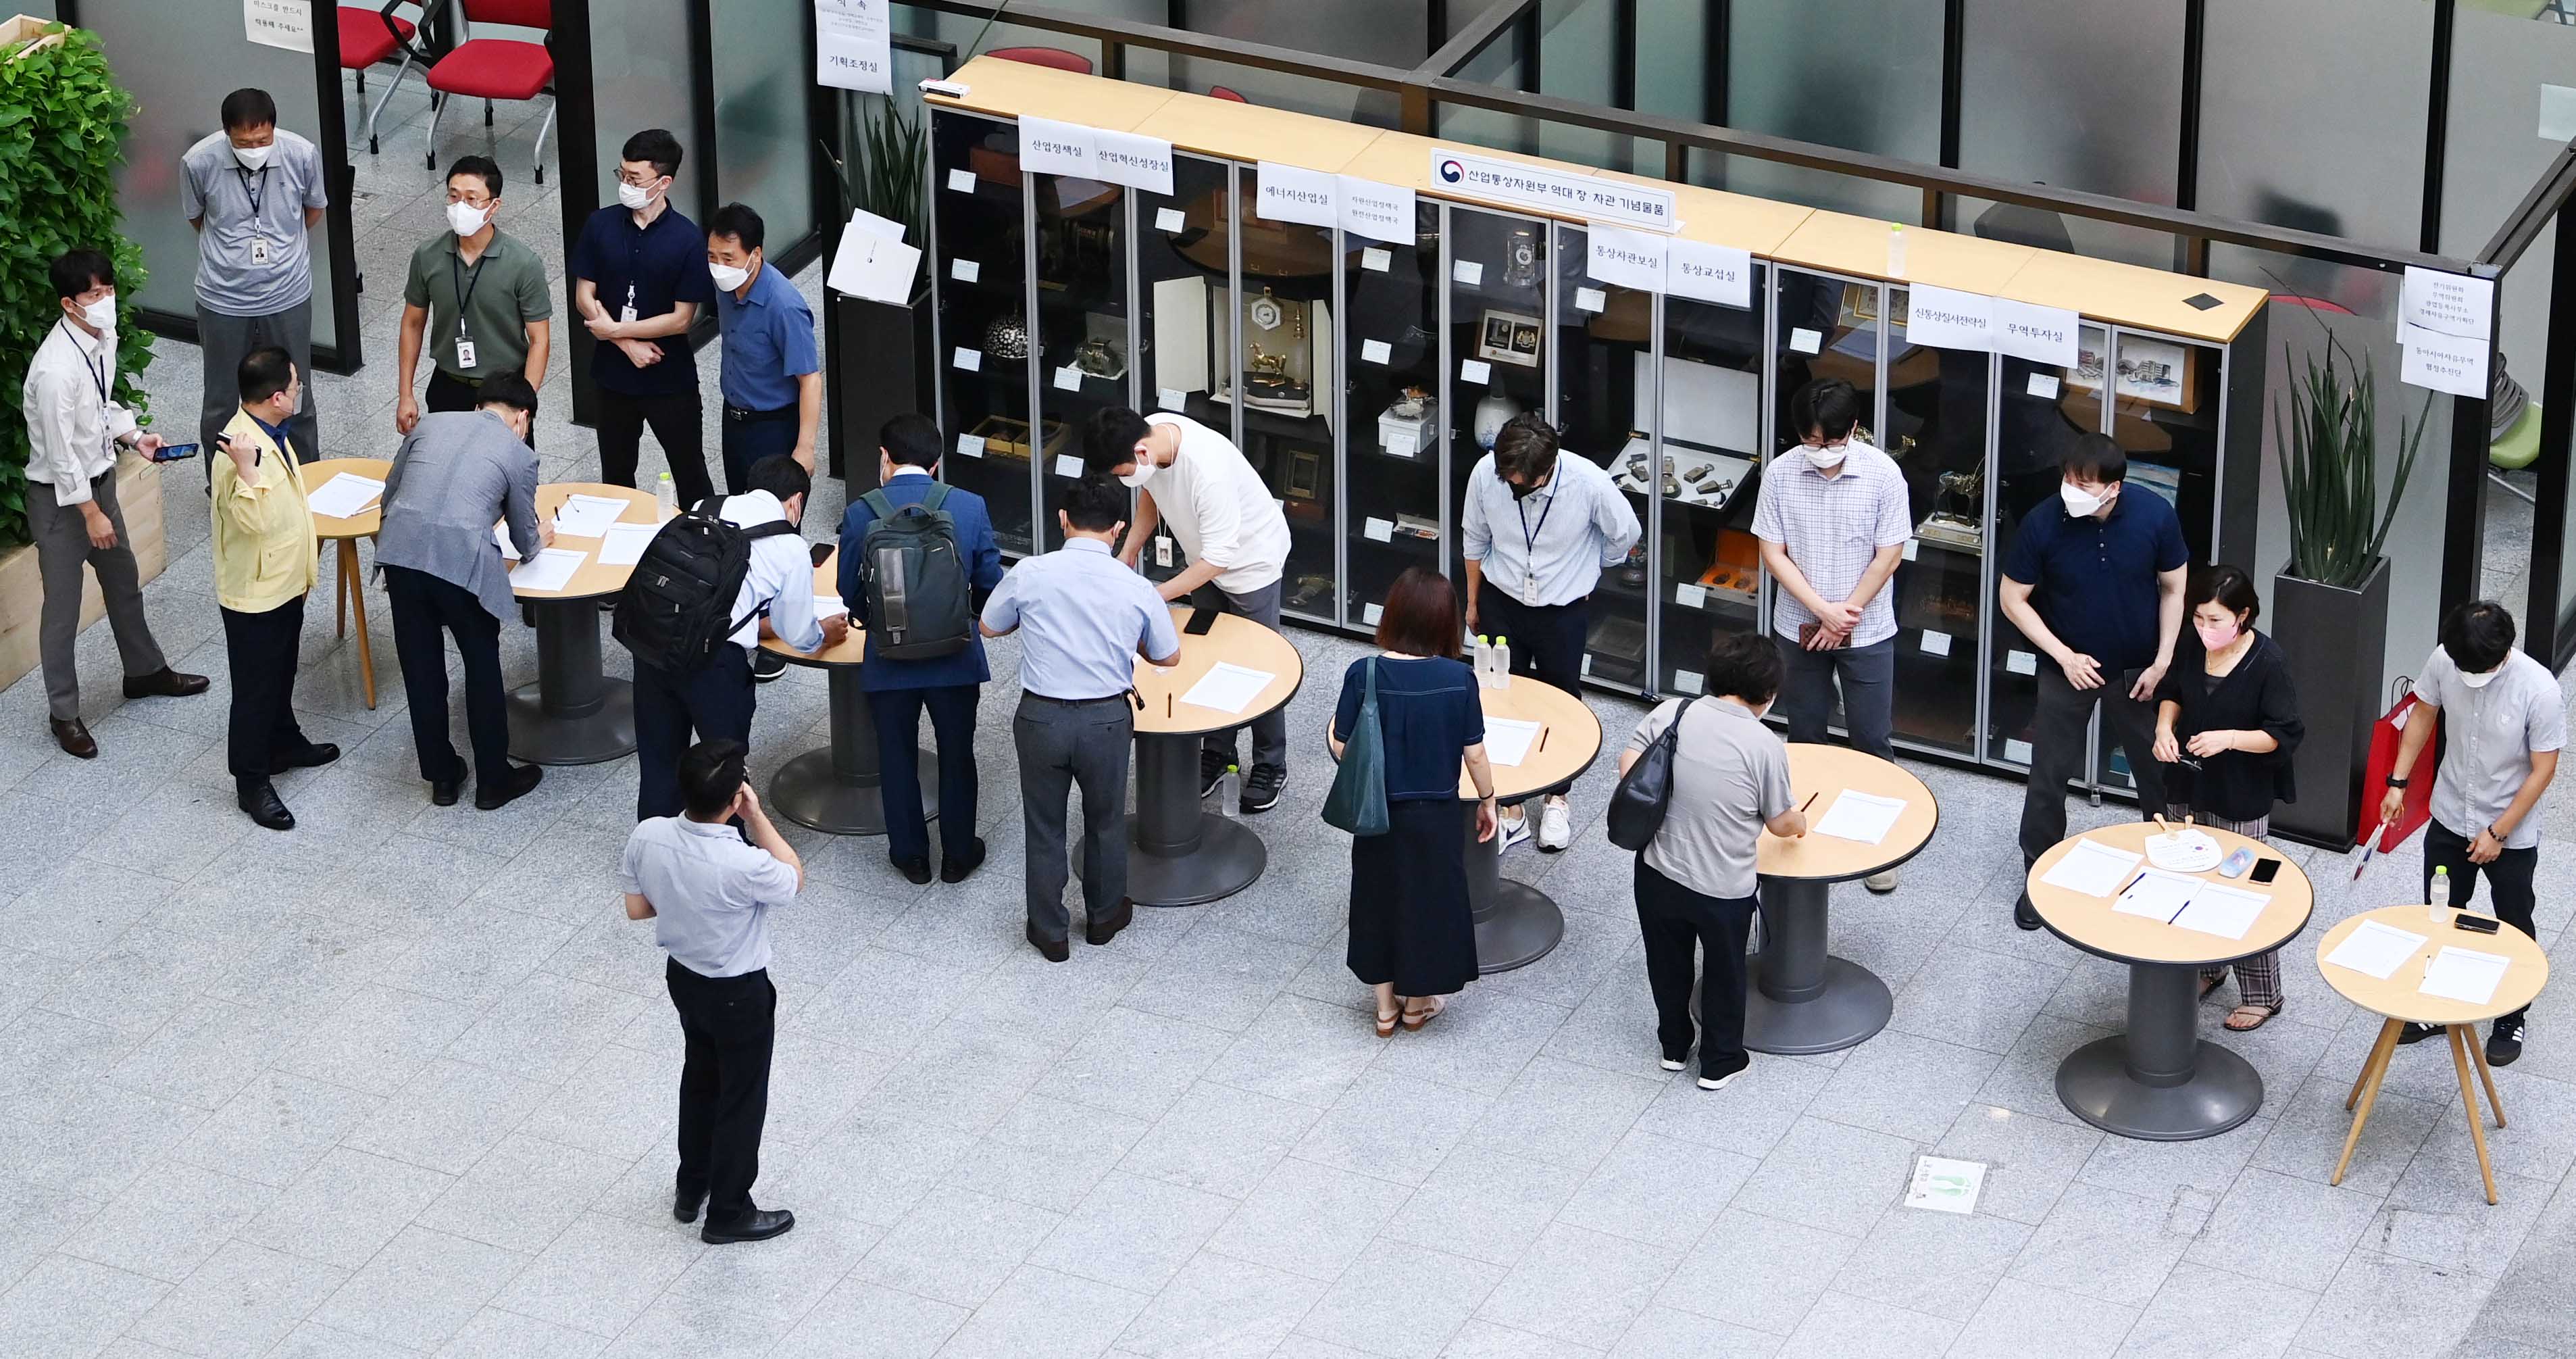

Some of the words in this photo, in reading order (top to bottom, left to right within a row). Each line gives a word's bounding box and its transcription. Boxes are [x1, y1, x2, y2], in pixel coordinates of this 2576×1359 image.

[282, 5, 302, 16] 반드시
[829, 55, 878, 73] 기획조정실
[1032, 140, 1082, 157] 산업정책실
[1098, 150, 1169, 172] 산업혁신성장실
[1265, 186, 1328, 205] 에너지산업실
[1469, 170, 1547, 193] 산업통상자원부
[1551, 184, 1573, 199] 역대
[1620, 197, 1664, 216] 기념물품
[1352, 195, 1399, 211] 자원산업정책국
[1352, 209, 1398, 225] 원전산업정책국
[1595, 245, 1657, 269] 통상차관보실
[1682, 263, 1735, 282] 통상교섭실
[1915, 307, 1986, 329] 신통상질서전략실
[2007, 323, 2063, 343] 무역투자실
